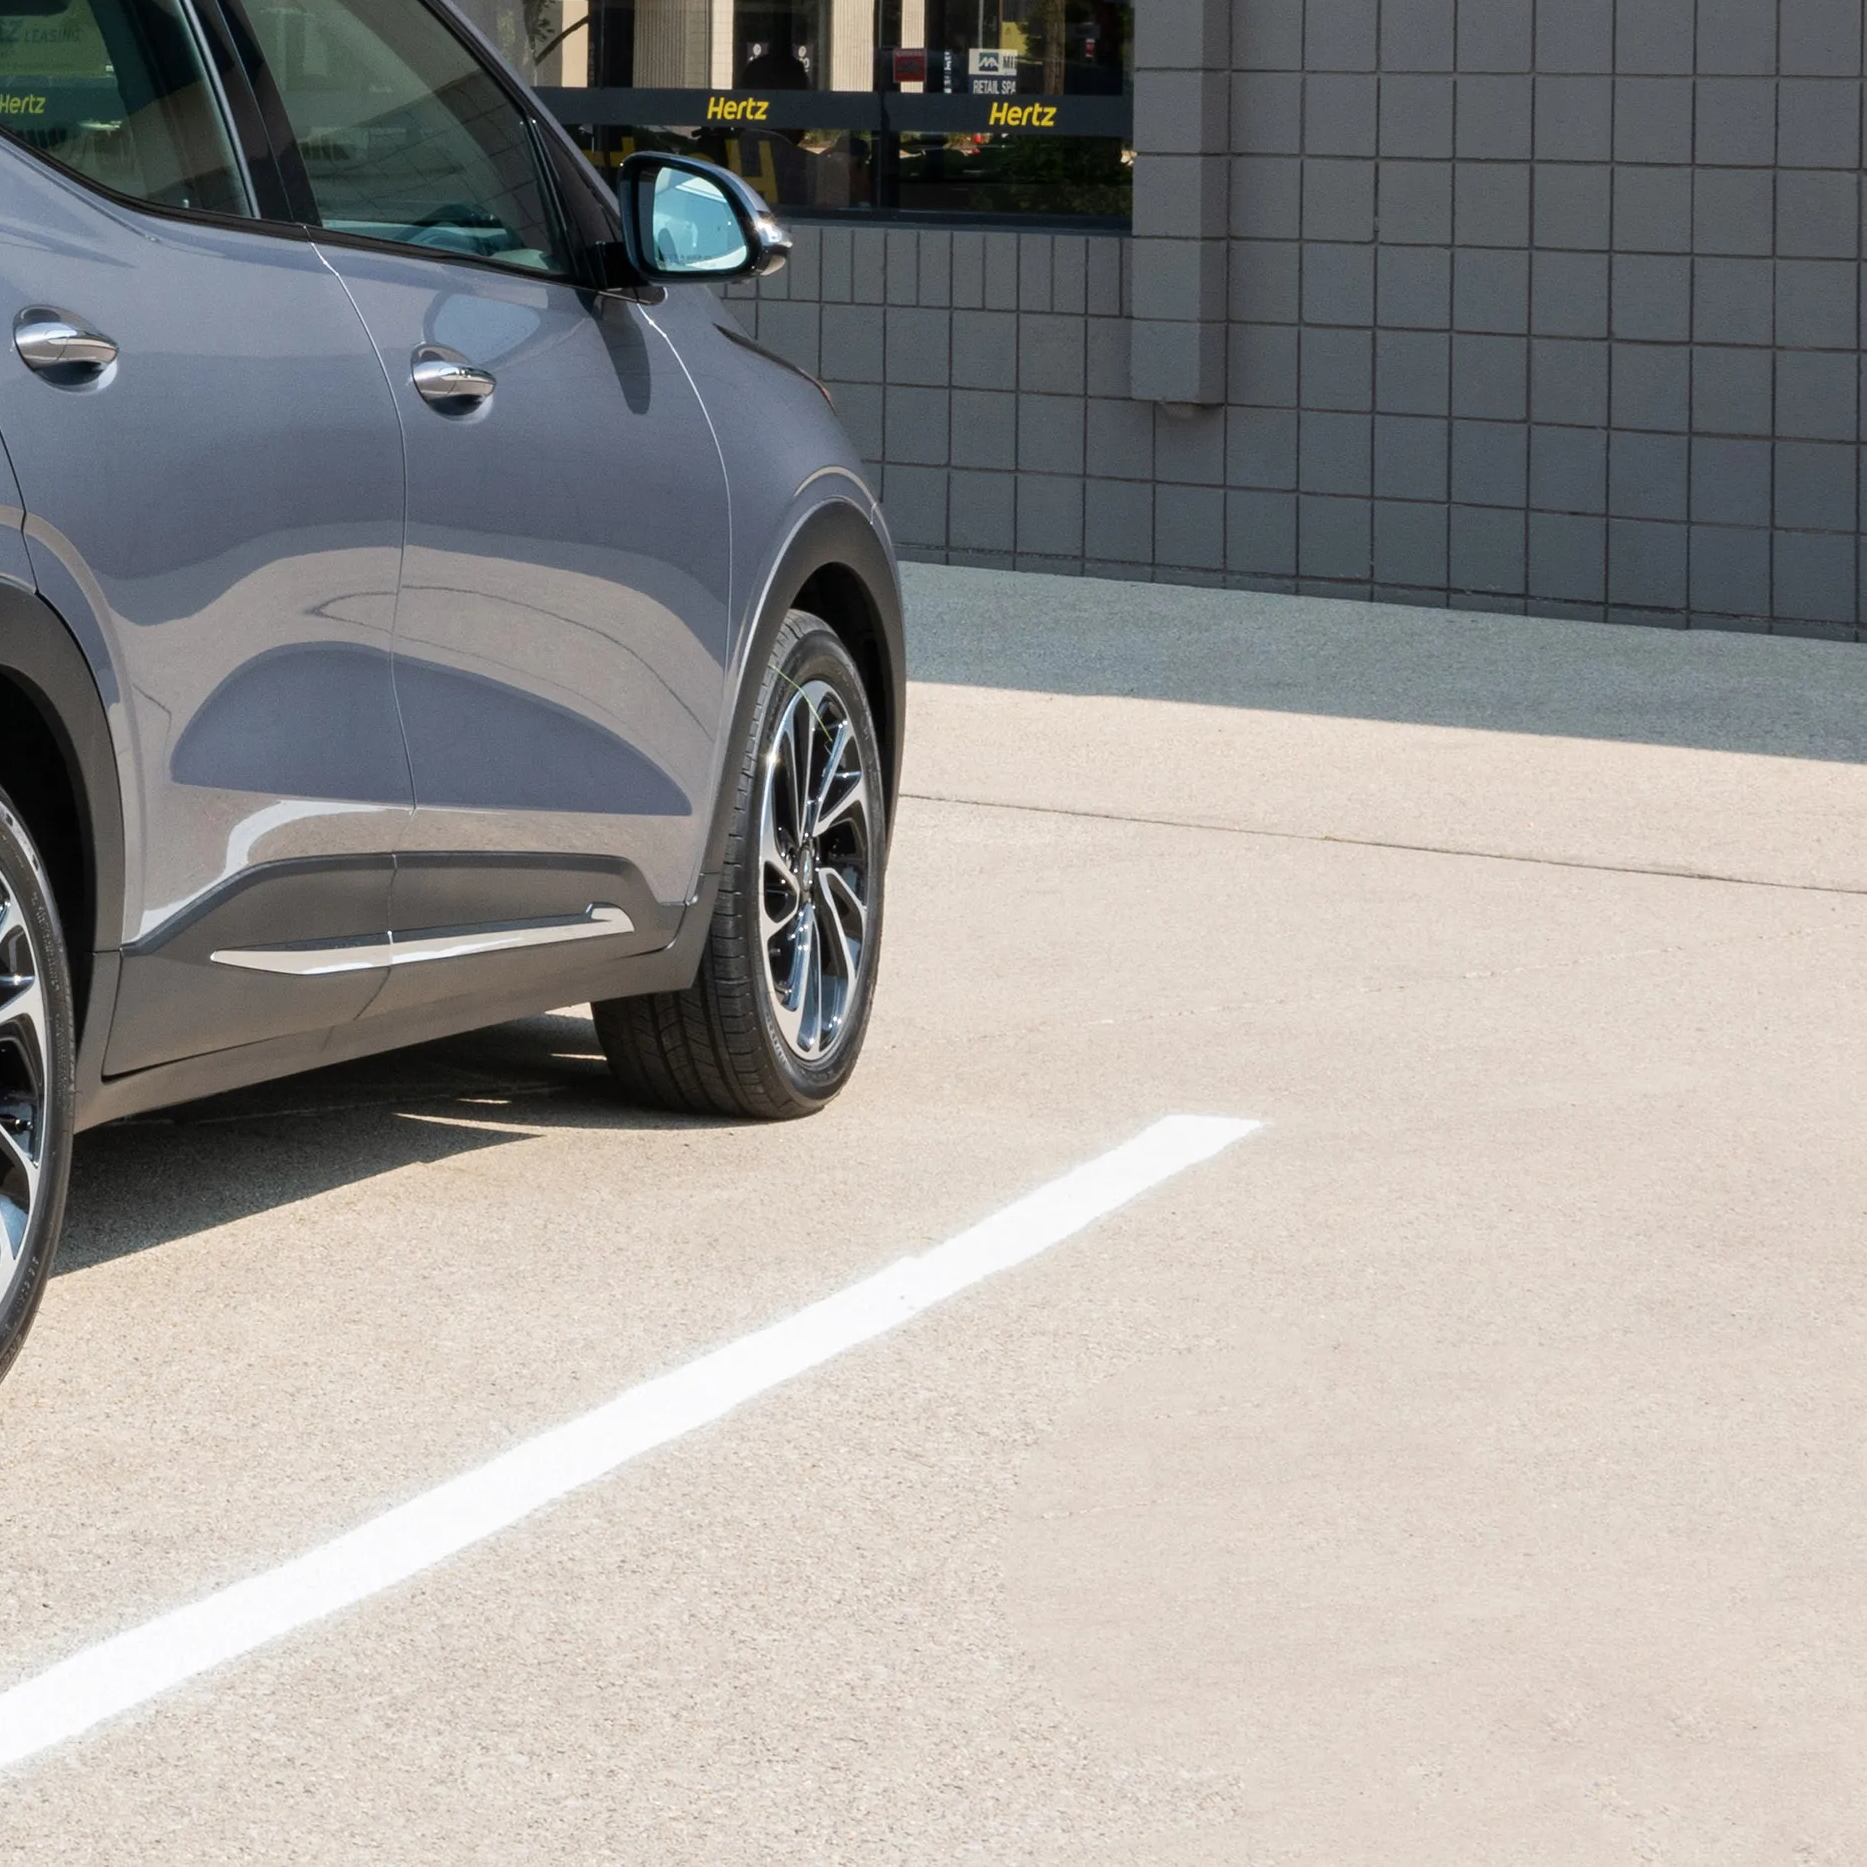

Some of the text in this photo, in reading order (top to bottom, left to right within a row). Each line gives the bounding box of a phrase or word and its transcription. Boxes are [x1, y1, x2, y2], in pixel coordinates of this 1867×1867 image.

[972, 80, 1000, 95] RETAIL
[707, 96, 770, 121] Hertz
[989, 101, 1058, 127] Hertz
